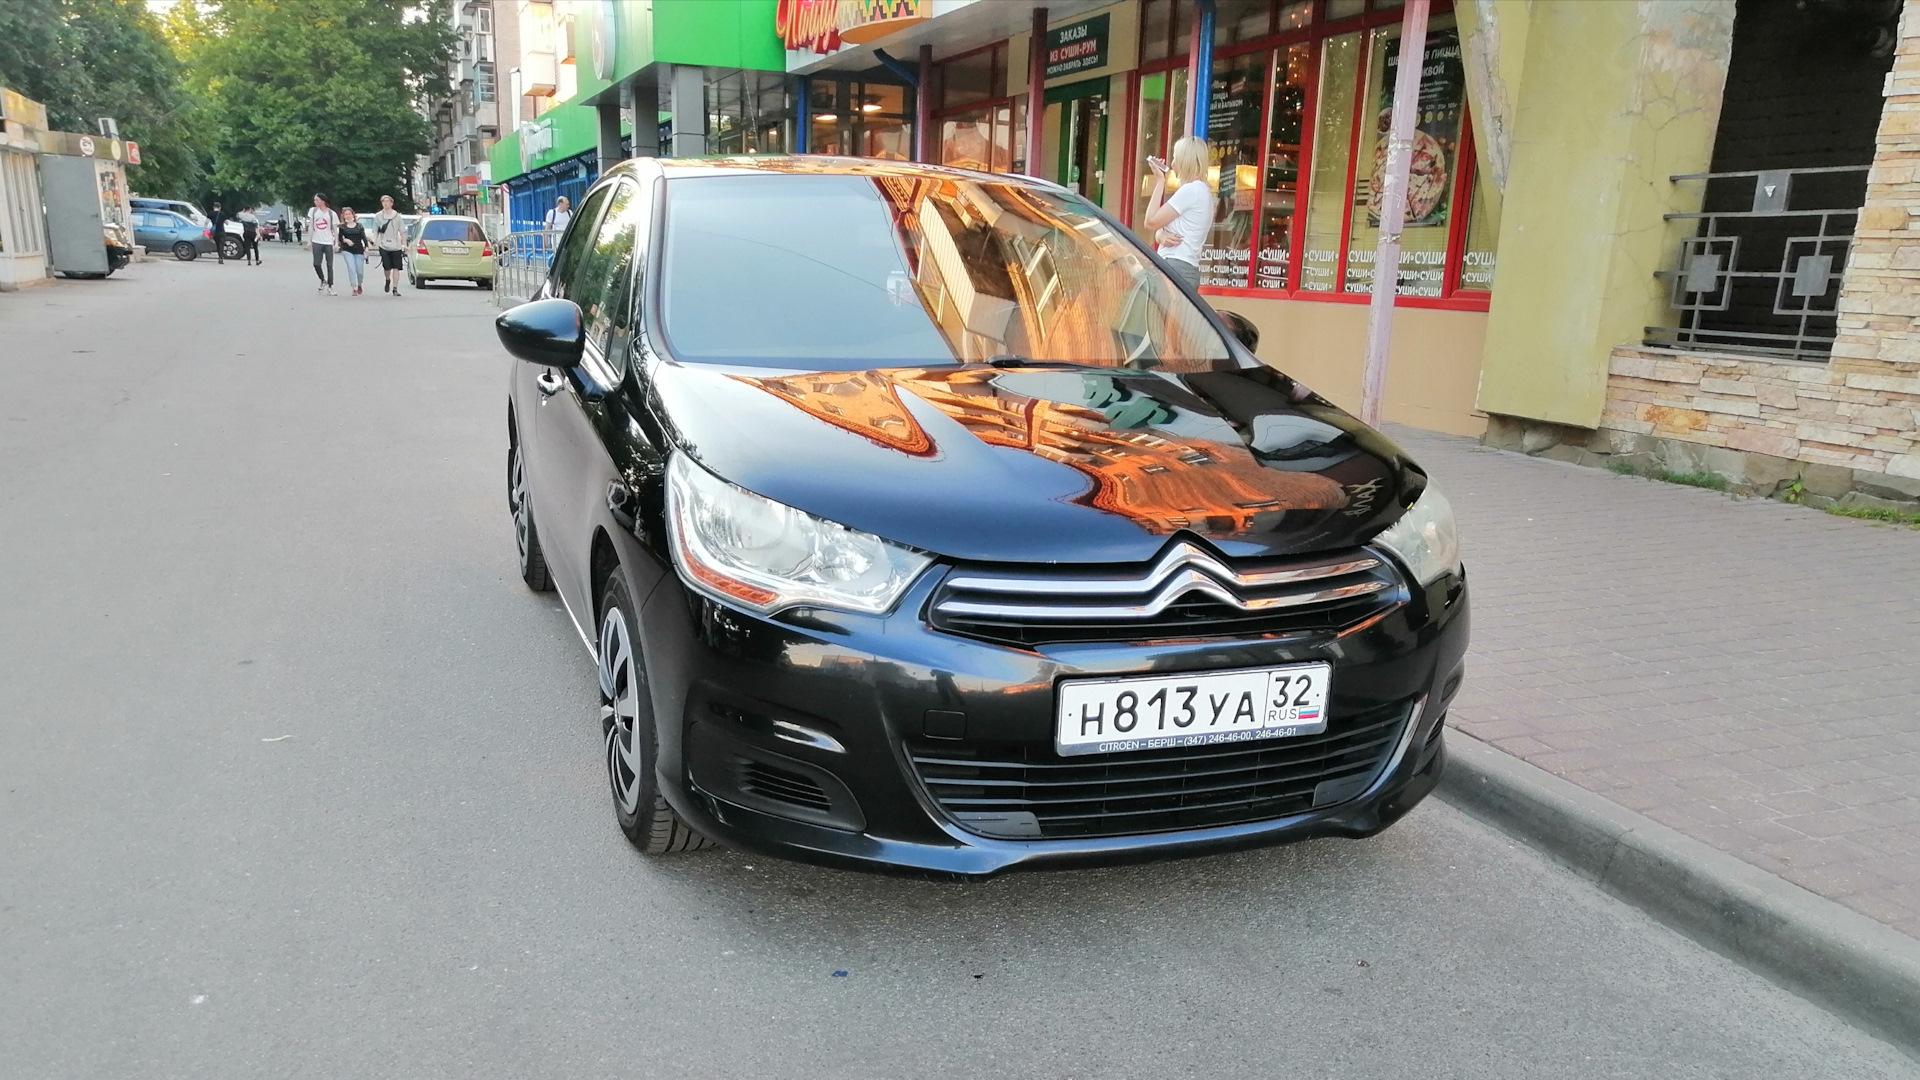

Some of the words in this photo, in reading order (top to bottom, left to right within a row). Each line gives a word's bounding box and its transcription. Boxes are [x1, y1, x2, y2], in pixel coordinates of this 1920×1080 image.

[1059, 25, 1088, 43] ЗАКАЗЫ
[1050, 50, 1059, 63] ИЗ
[1060, 39, 1097, 60] СУШИ-РУМ
[1205, 249, 1227, 260] СУШИ
[1262, 249, 1286, 261] СУШИ
[1309, 249, 1335, 262] СУШИ
[1349, 250, 1377, 263] СУШИ
[1415, 251, 1447, 265] СУШИ
[1263, 265, 1281, 275] СУШИ
[1310, 267, 1330, 277] СУШИ
[1347, 268, 1368, 279] СУШИ
[1419, 271, 1444, 281] СУШИ
[1466, 272, 1492, 283] СУШИ
[1261, 279, 1280, 289] СУШИ
[1308, 282, 1328, 291] СУШИ
[1345, 283, 1366, 293] СУШИ
[1418, 286, 1442, 297] СУШИ
[1272, 674, 1312, 708] 32
[1268, 709, 1298, 722] RUS
[1099, 739, 1140, 752] CITROEN
[1255, 727, 1297, 741] 246-46-01
